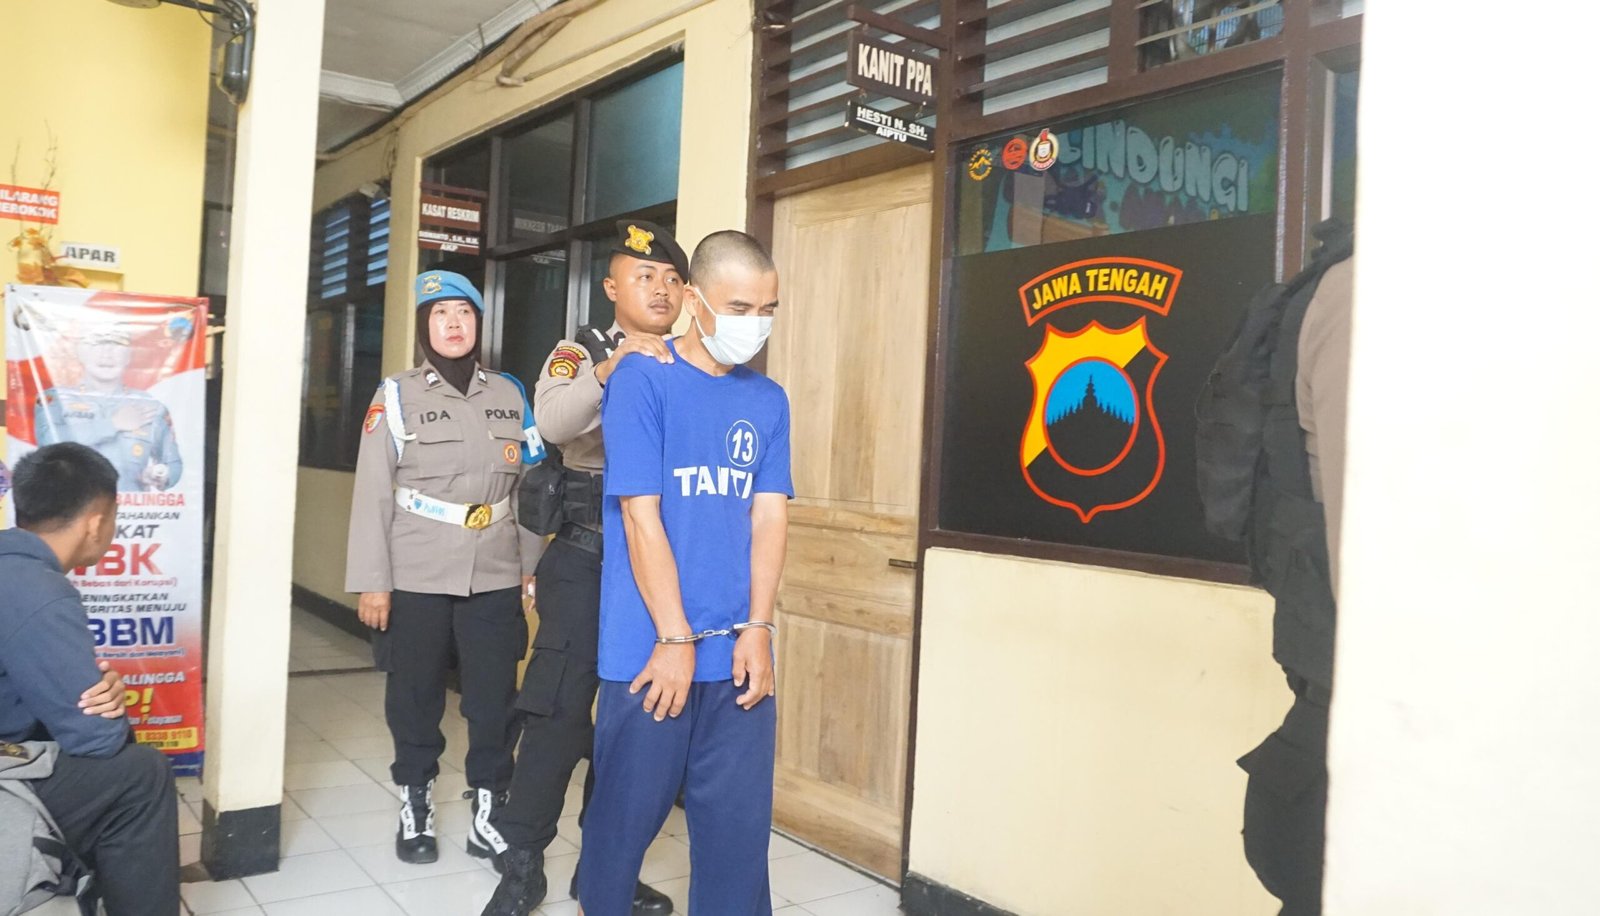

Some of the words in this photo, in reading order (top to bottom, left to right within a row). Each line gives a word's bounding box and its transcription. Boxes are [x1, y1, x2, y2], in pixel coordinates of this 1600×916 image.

[858, 43, 905, 87] KANIT
[906, 58, 933, 97] PPA
[857, 106, 892, 127] HESTI
[894, 118, 907, 131] N.
[908, 123, 928, 138] SH.
[876, 126, 907, 143] AIPTU
[422, 202, 447, 218] KASAT
[66, 246, 116, 264] APAR
[1032, 272, 1082, 310] JAWA
[1085, 267, 1169, 301] TENGAH
[420, 405, 452, 424] IDA
[484, 404, 521, 420] POLRI
[732, 428, 754, 462] 13
[135, 602, 187, 613] MENUJU
